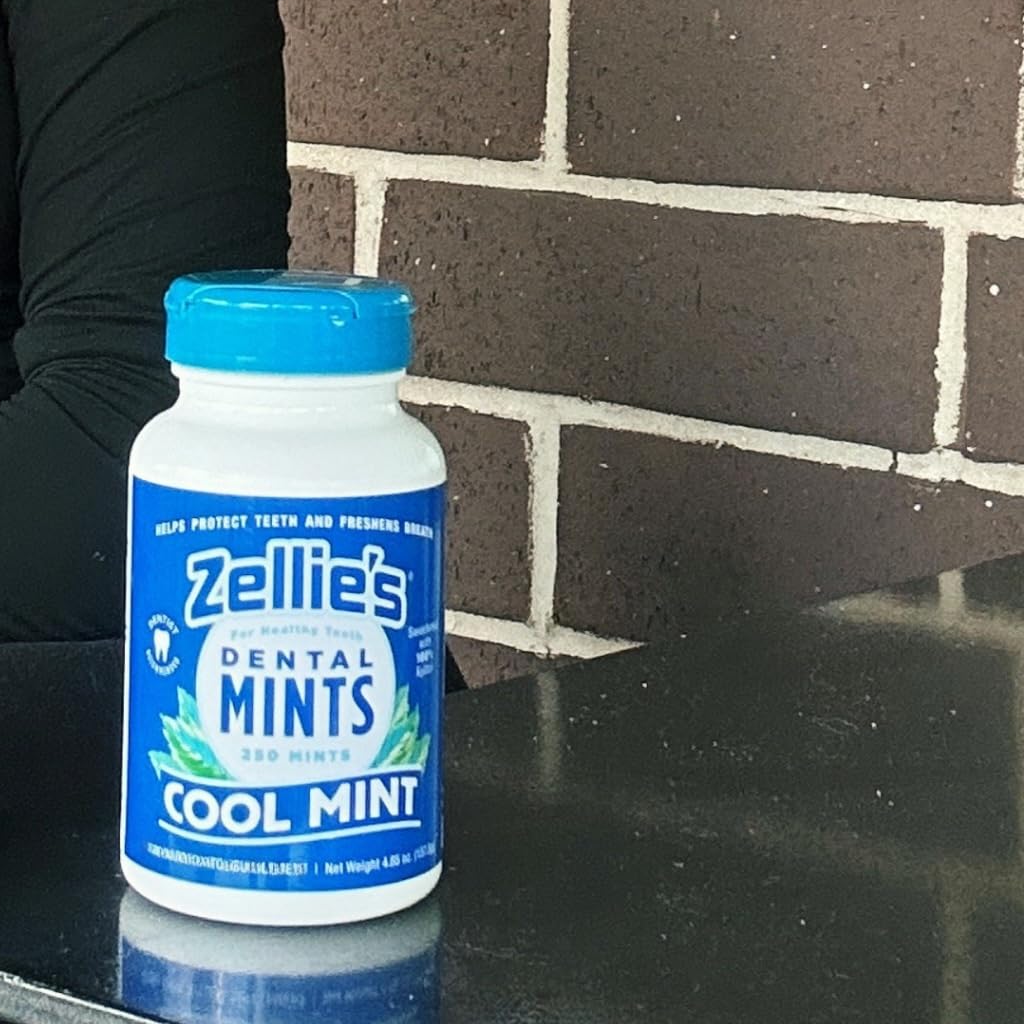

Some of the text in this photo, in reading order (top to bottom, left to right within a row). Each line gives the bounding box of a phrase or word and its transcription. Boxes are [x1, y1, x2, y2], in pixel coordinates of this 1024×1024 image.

[155, 518, 186, 536] HELPS
[191, 514, 248, 532] PROTECT
[254, 514, 298, 528] TEETH
[305, 514, 333, 529] AND
[340, 515, 400, 533] FRESHENS
[184, 538, 408, 630] Zellie's
[230, 624, 363, 641] For Healthy Teeth
[221, 647, 374, 670] DENTAL
[220, 674, 375, 737] MINTS
[289, 748, 351, 763] MINTS
[163, 776, 418, 834] COOL MINT
[324, 861, 344, 875] Net
[345, 858, 380, 874] Weight
